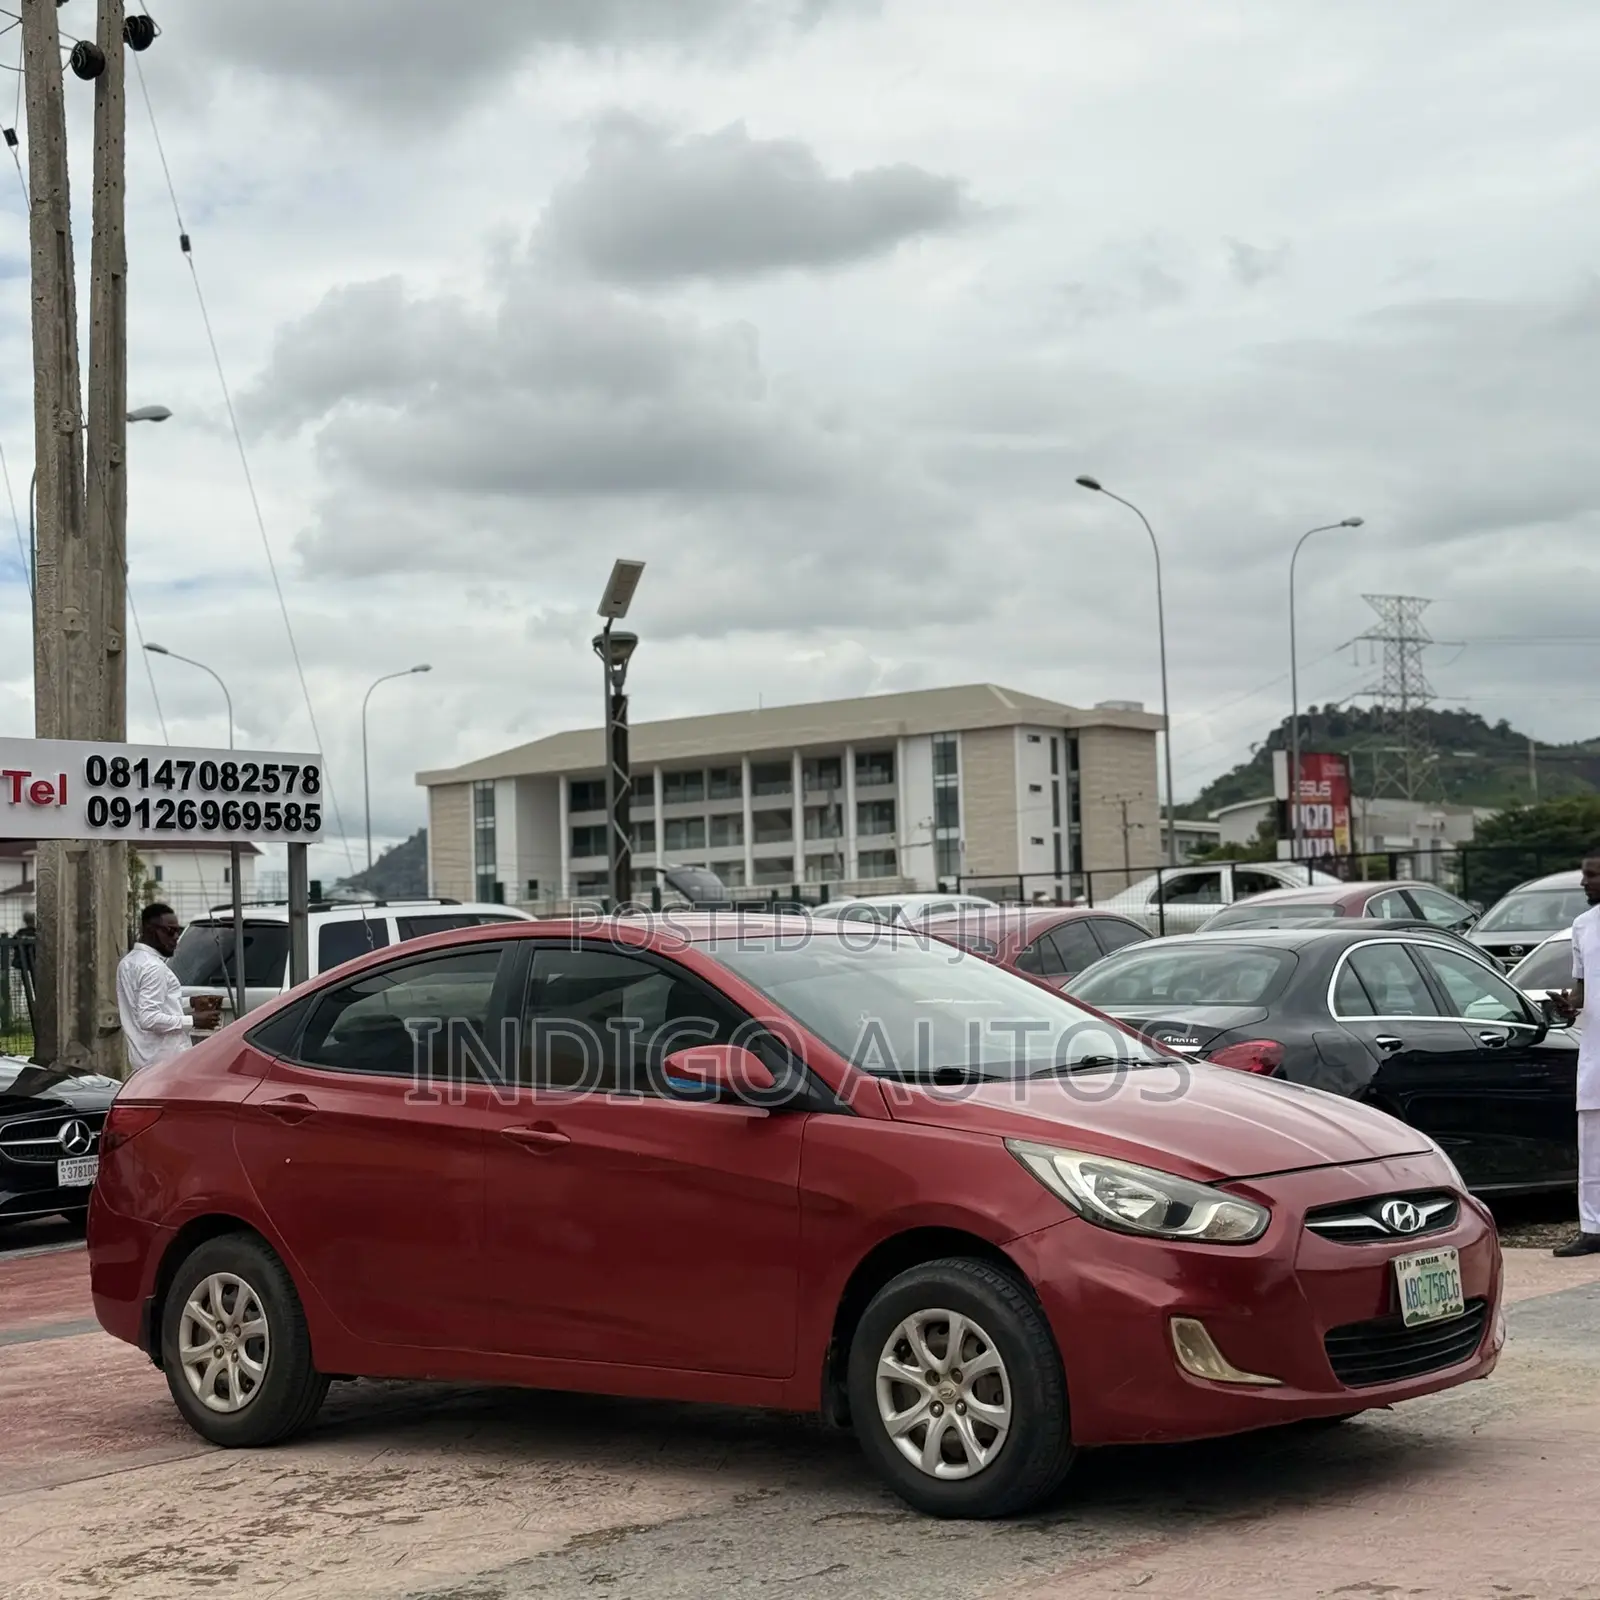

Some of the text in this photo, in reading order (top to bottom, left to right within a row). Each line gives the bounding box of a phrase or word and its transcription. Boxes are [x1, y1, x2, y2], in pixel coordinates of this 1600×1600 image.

[2, 769, 67, 806] Tel
[85, 754, 320, 794] 08147082578
[87, 795, 322, 832] 09126969585
[1415, 1255, 1439, 1267] ABUJA
